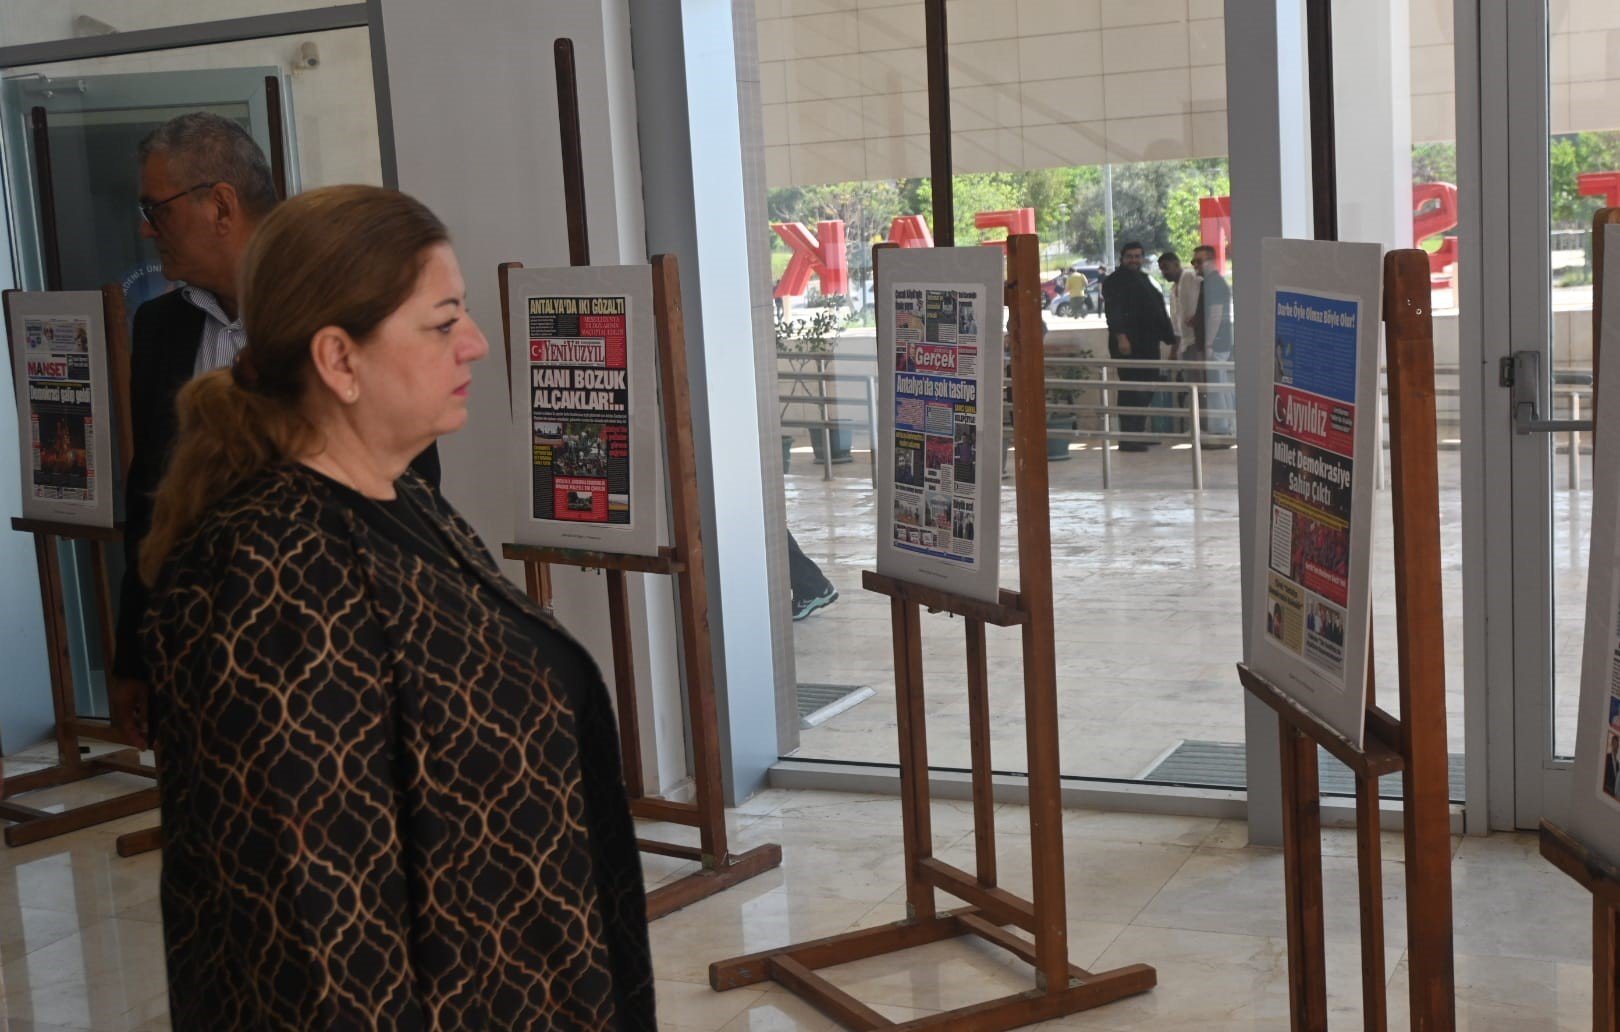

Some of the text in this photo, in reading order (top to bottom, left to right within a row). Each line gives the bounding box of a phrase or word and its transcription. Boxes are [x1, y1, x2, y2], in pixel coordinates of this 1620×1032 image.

[915, 346, 955, 369] Gerçek
[533, 369, 626, 390] KANI BOZUK
[1274, 441, 1350, 490] Millet Demokrasiye
[1289, 472, 1331, 506] Sahip Çıktı
